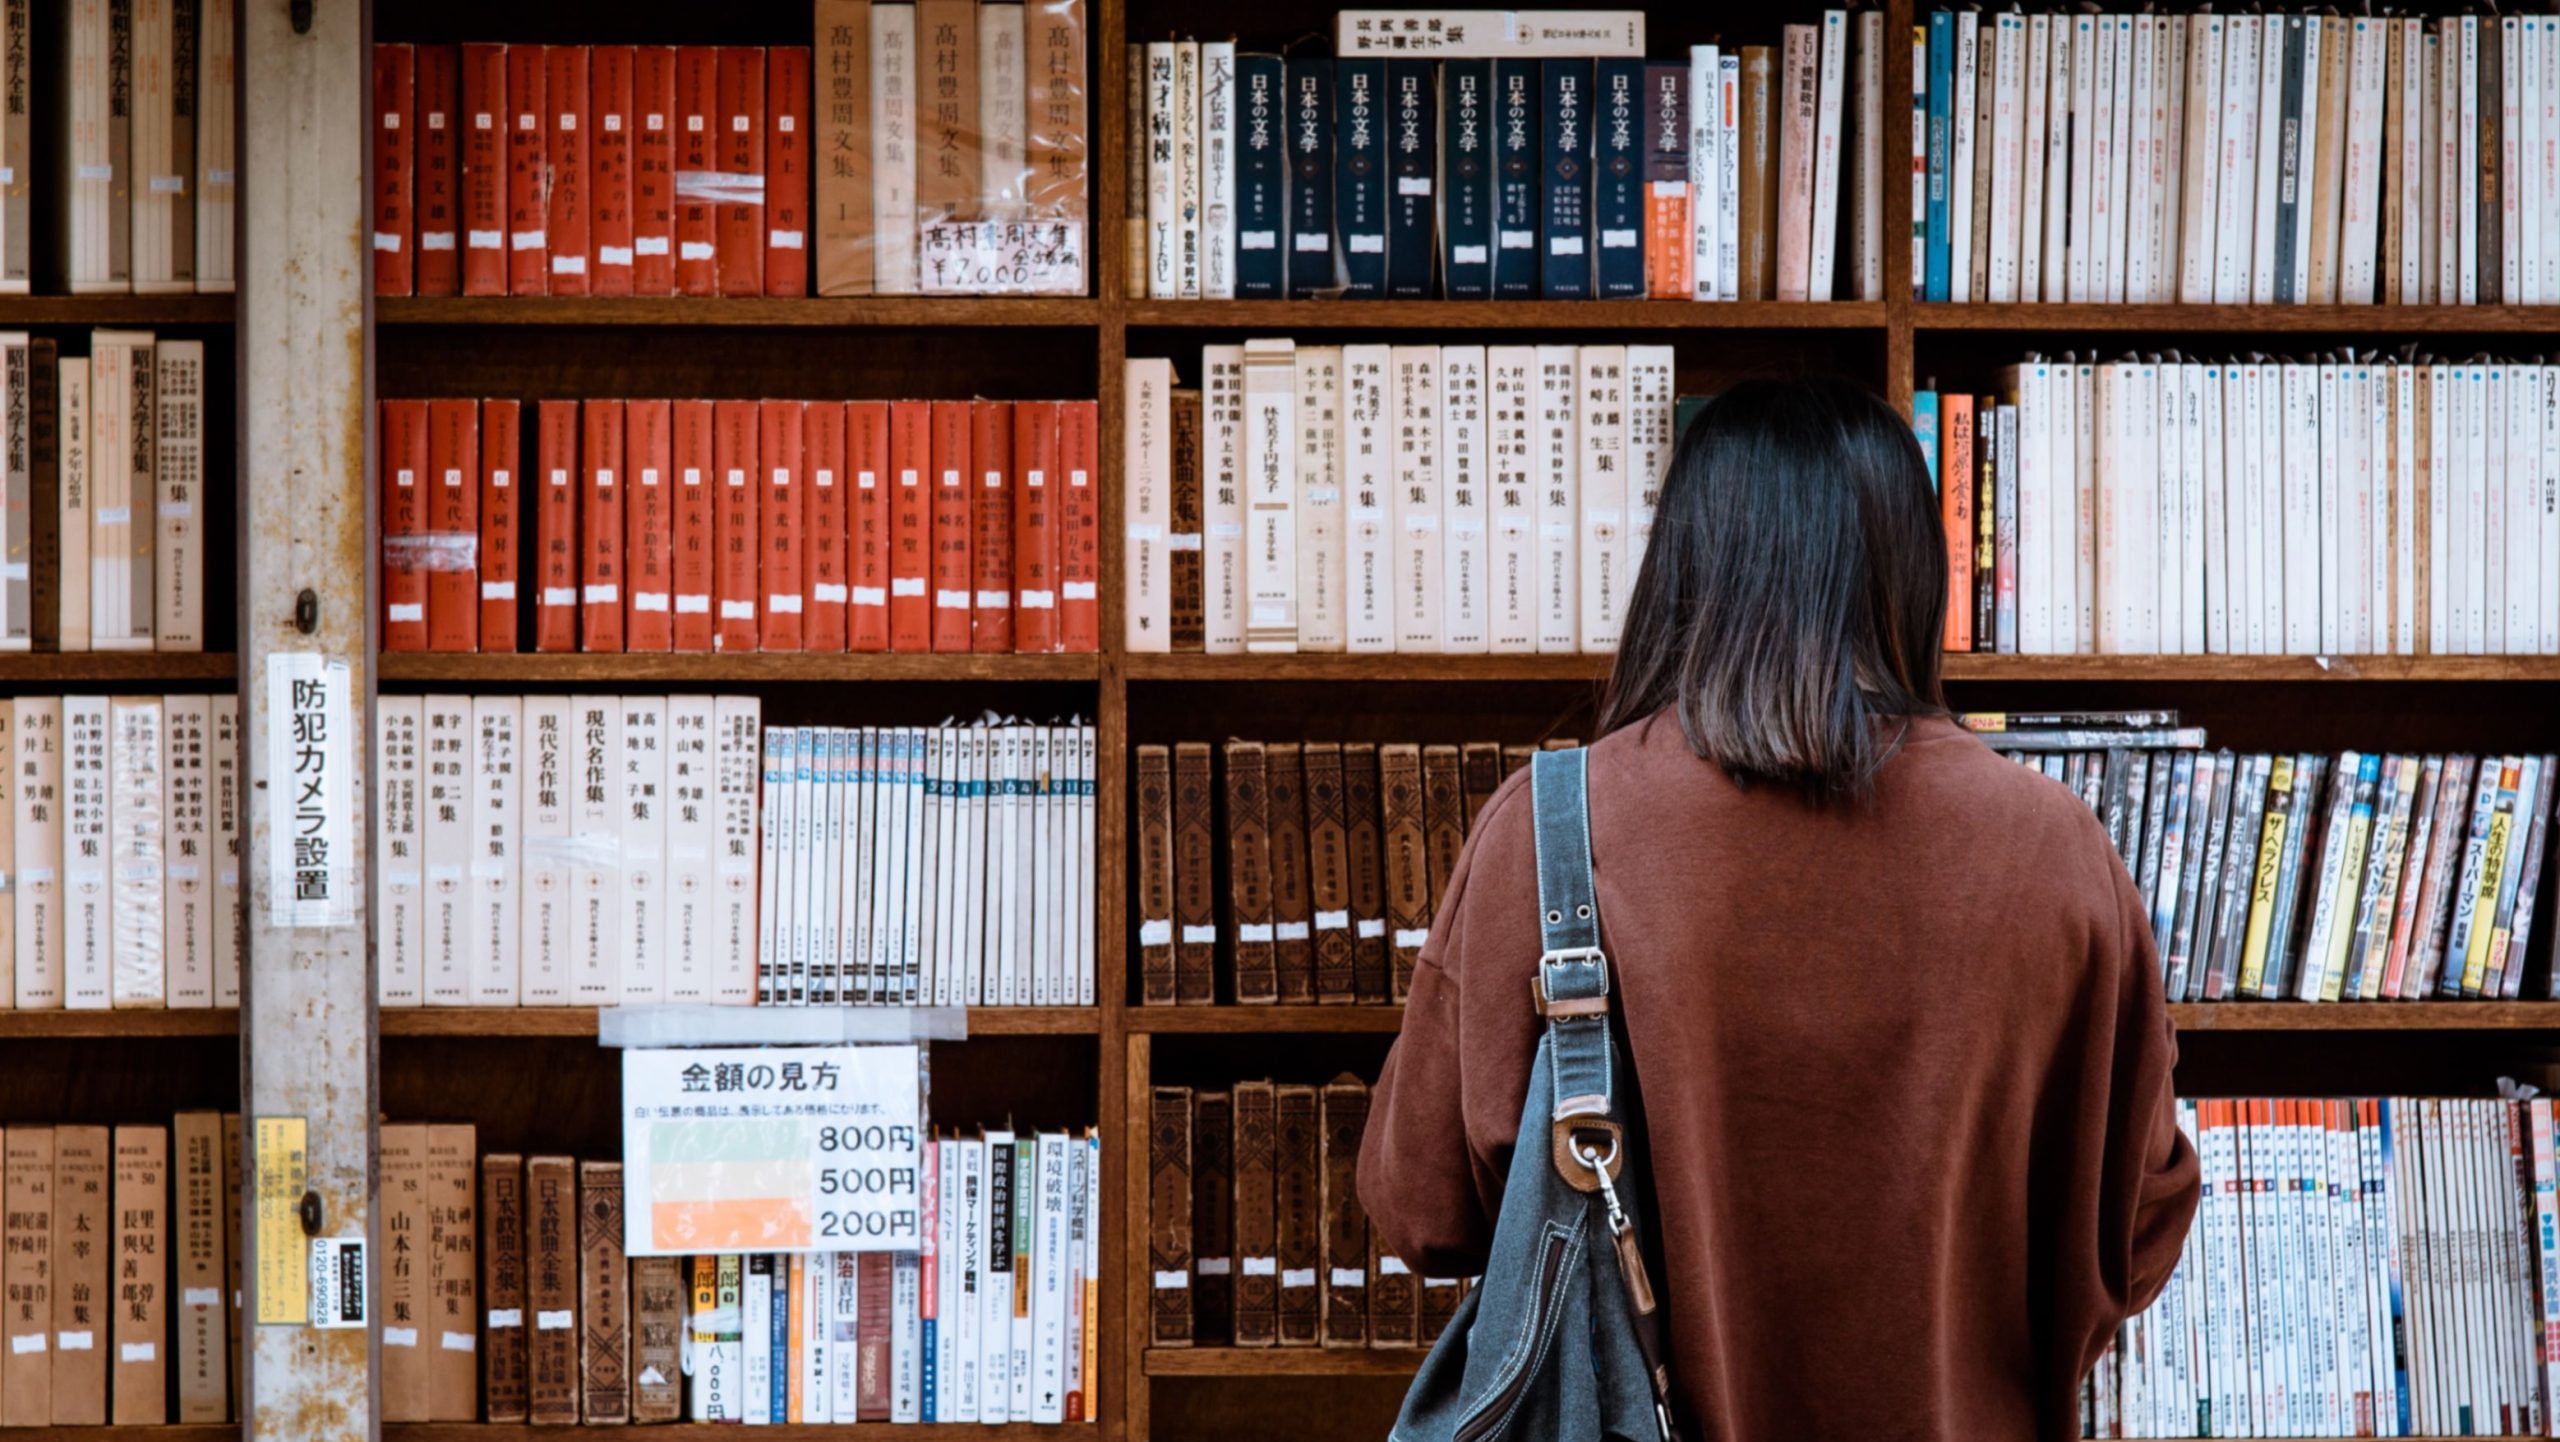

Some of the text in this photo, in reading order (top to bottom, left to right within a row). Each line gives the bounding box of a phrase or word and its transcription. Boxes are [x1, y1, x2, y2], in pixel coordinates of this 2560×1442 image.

[1250, 74, 1269, 150] 日本の文学
[1300, 76, 1319, 153] 日本の文学
[1350, 74, 1370, 150] 日本の文学
[1400, 76, 1420, 152] 日本の文学
[1459, 75, 1478, 152] 日本の文学
[1507, 75, 1526, 151] 日本の文学
[1558, 76, 1578, 152] 日本の文学
[1611, 74, 1631, 151] 日本の文学
[1658, 75, 1678, 152] 日本の文学
[7, 349, 24, 474] 昭和文学全集
[132, 349, 149, 474] 昭和文学全集
[293, 679, 329, 900] 防犯カメラ設置
[539, 715, 558, 808] 現代名作集
[586, 709, 605, 803] 現代名作集
[1006, 783, 1015, 794] 6
[2459, 843, 2482, 917] スーパーマン
[682, 1062, 840, 1092] 金額の見方
[820, 1126, 914, 1152] 800円
[1047, 1141, 1062, 1211] 環境破壊
[820, 1168, 915, 1194] 500円
[821, 1211, 916, 1237] 200円
